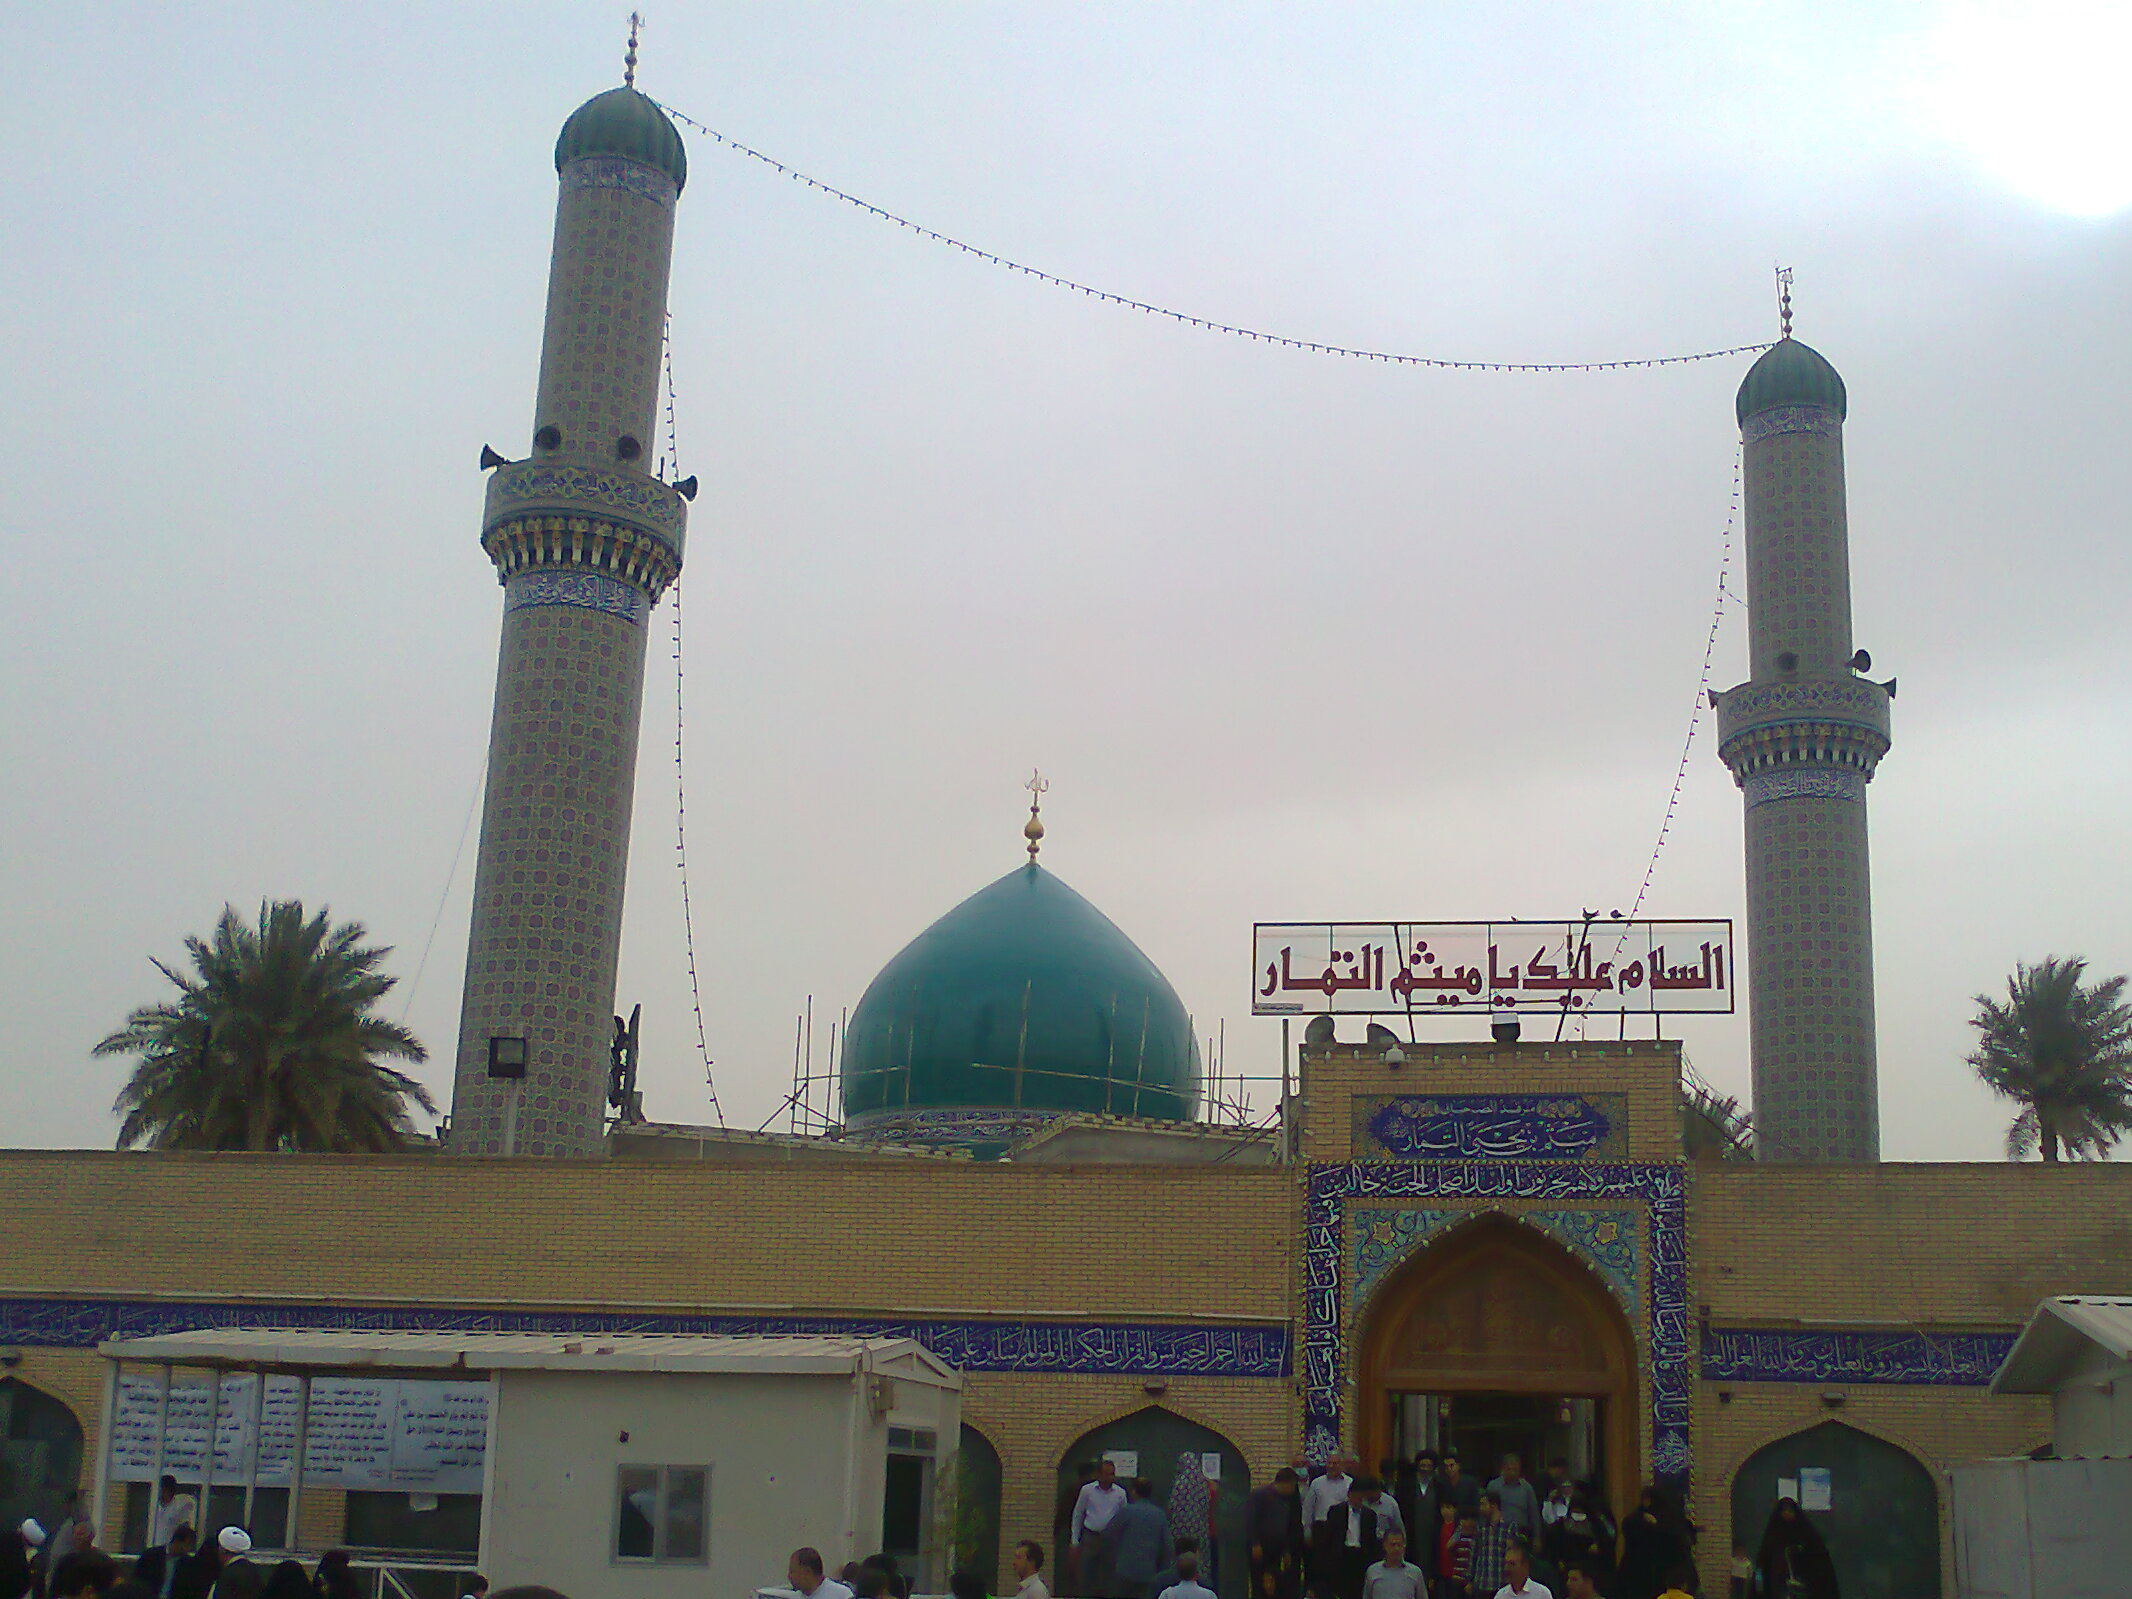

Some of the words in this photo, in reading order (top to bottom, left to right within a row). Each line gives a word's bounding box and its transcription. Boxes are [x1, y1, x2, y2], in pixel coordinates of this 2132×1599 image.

[1259, 942, 1384, 997] التمار
[1389, 941, 1483, 1007] ميثم
[1487, 943, 1519, 1008] يا
[1522, 941, 1614, 1007] عليك
[1618, 941, 1725, 995] السلام
